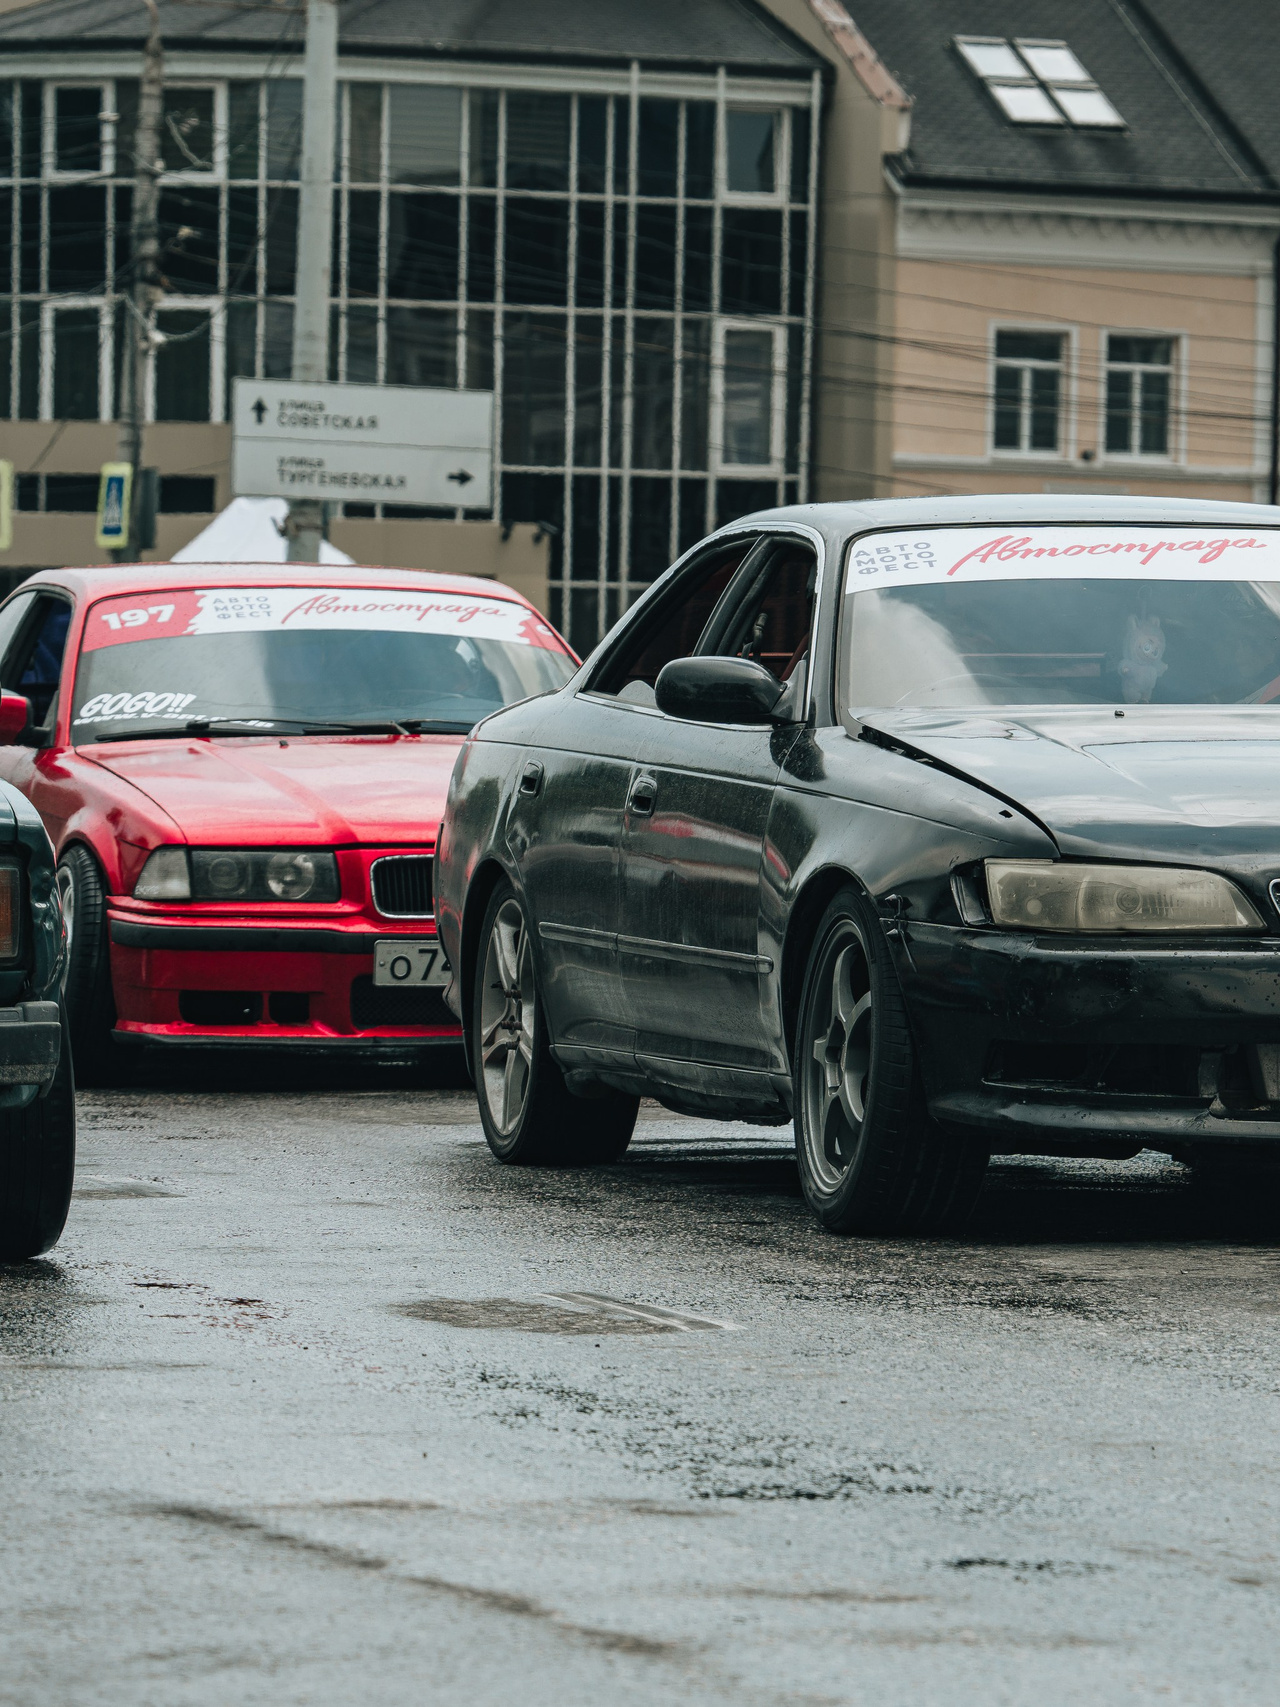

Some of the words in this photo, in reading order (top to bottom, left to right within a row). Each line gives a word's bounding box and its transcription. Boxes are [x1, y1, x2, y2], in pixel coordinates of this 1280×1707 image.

[277, 412, 378, 429] СОВЕТСКАЯ
[277, 468, 407, 488] ТУРГЕНЕВСКАЯ
[854, 542, 931, 559] АВТО
[855, 551, 934, 567] МОТО
[946, 535, 1267, 576] Автострада
[858, 560, 937, 575] ФЕСТ
[213, 596, 269, 604] АВТО
[214, 603, 271, 612] МОТО
[101, 604, 175, 630] 197
[216, 611, 273, 619] ФЕСТ
[281, 594, 507, 624] Автострада
[79, 691, 197, 718] GOGO!!
